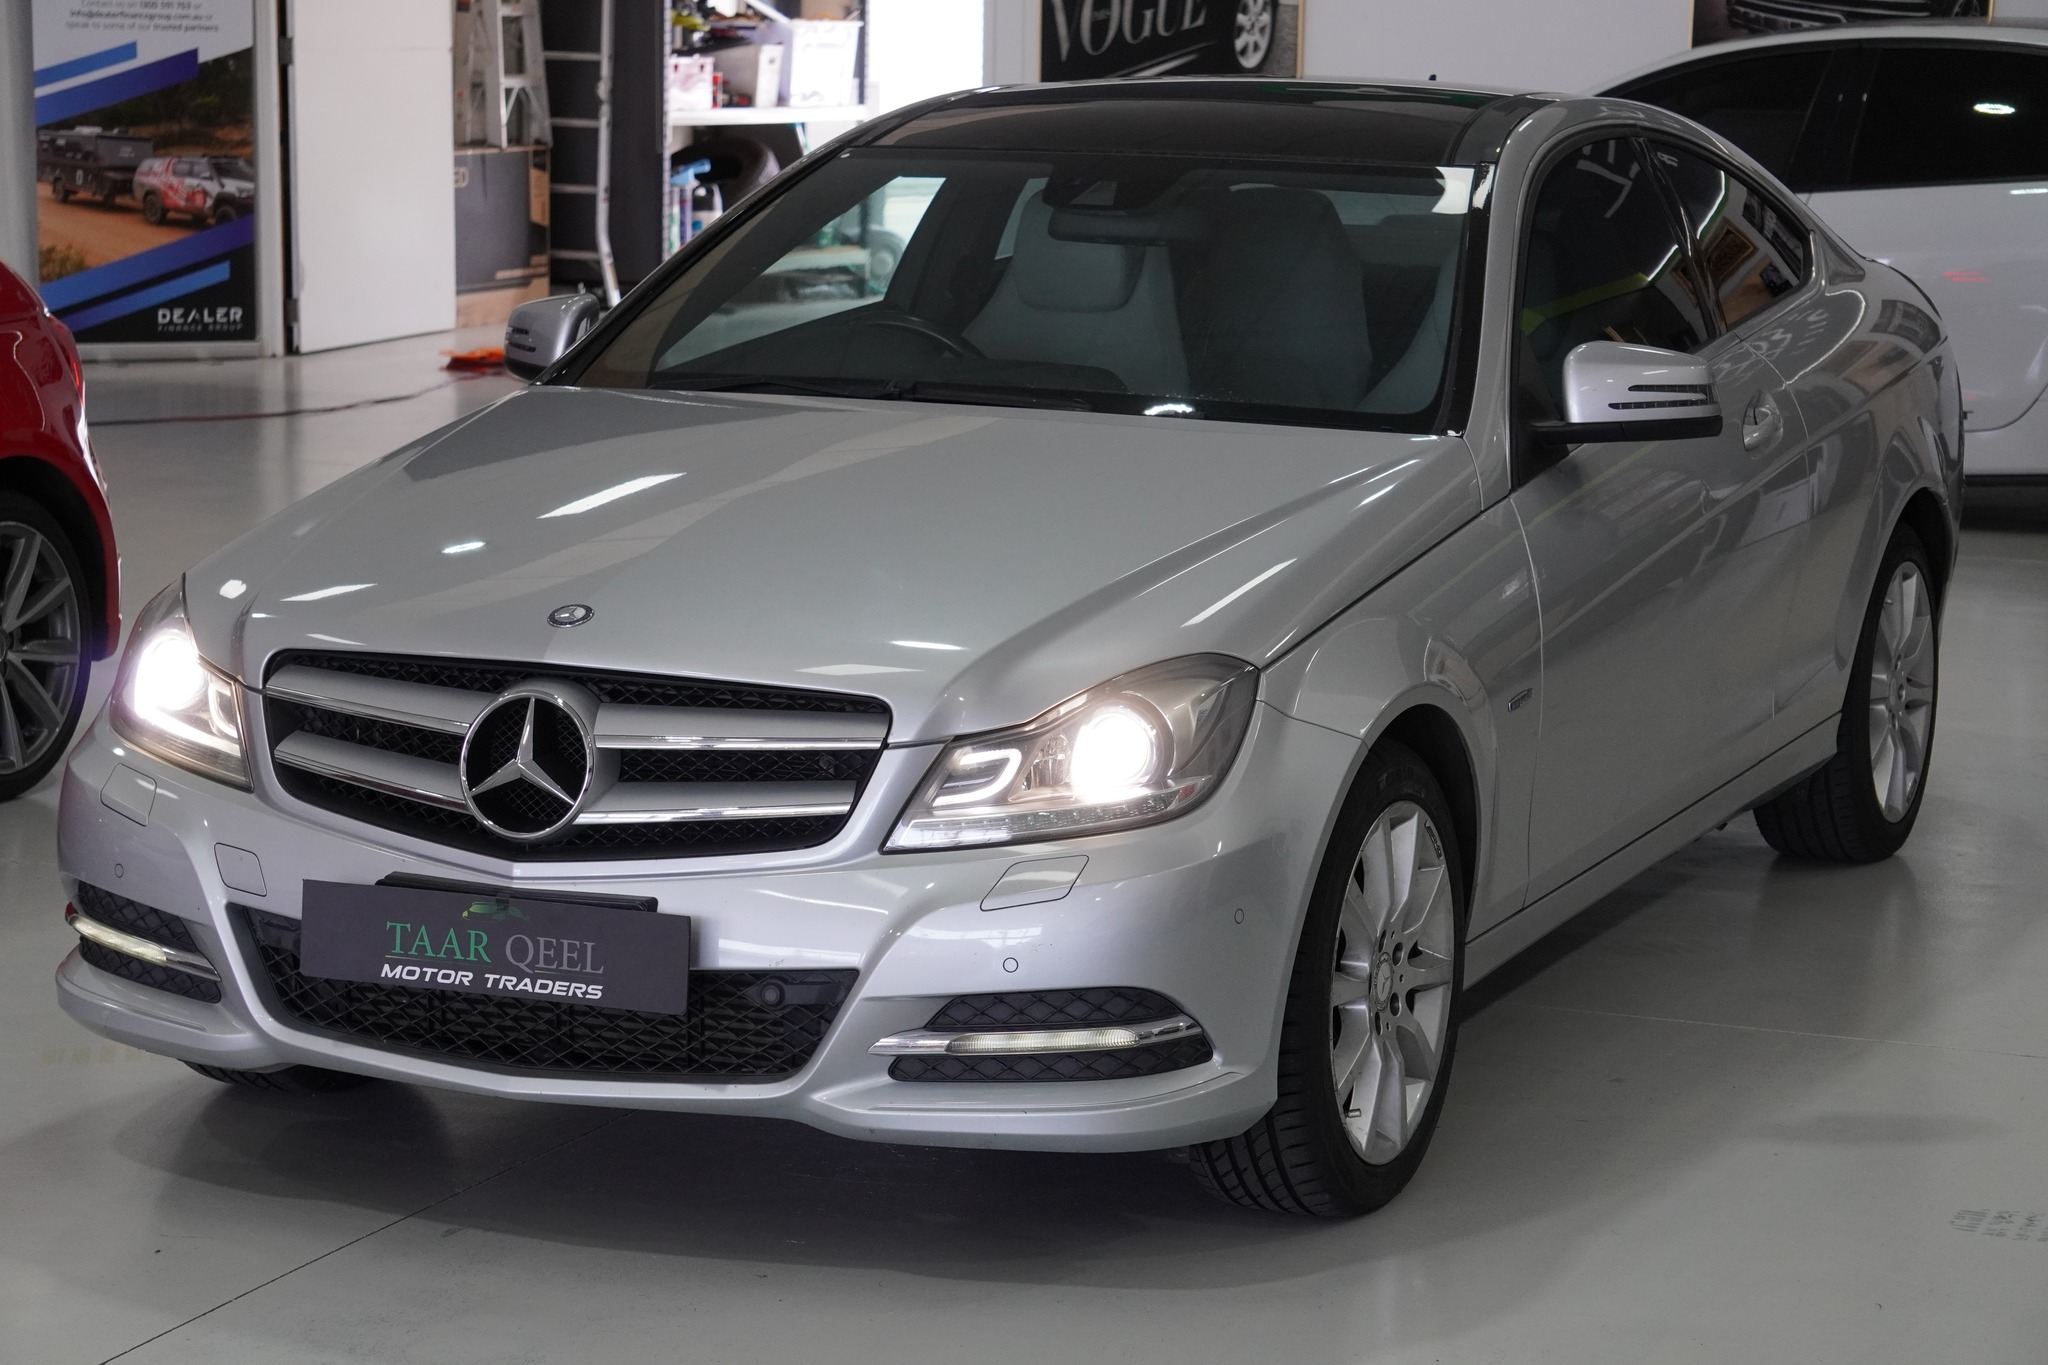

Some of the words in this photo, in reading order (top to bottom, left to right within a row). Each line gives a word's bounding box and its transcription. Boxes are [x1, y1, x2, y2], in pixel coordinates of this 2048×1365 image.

[157, 307, 243, 324] DEALER
[386, 921, 492, 963] TAAR
[504, 934, 605, 974] QEEL
[380, 963, 473, 987] MOTOR
[483, 974, 605, 1000] TRADERS
